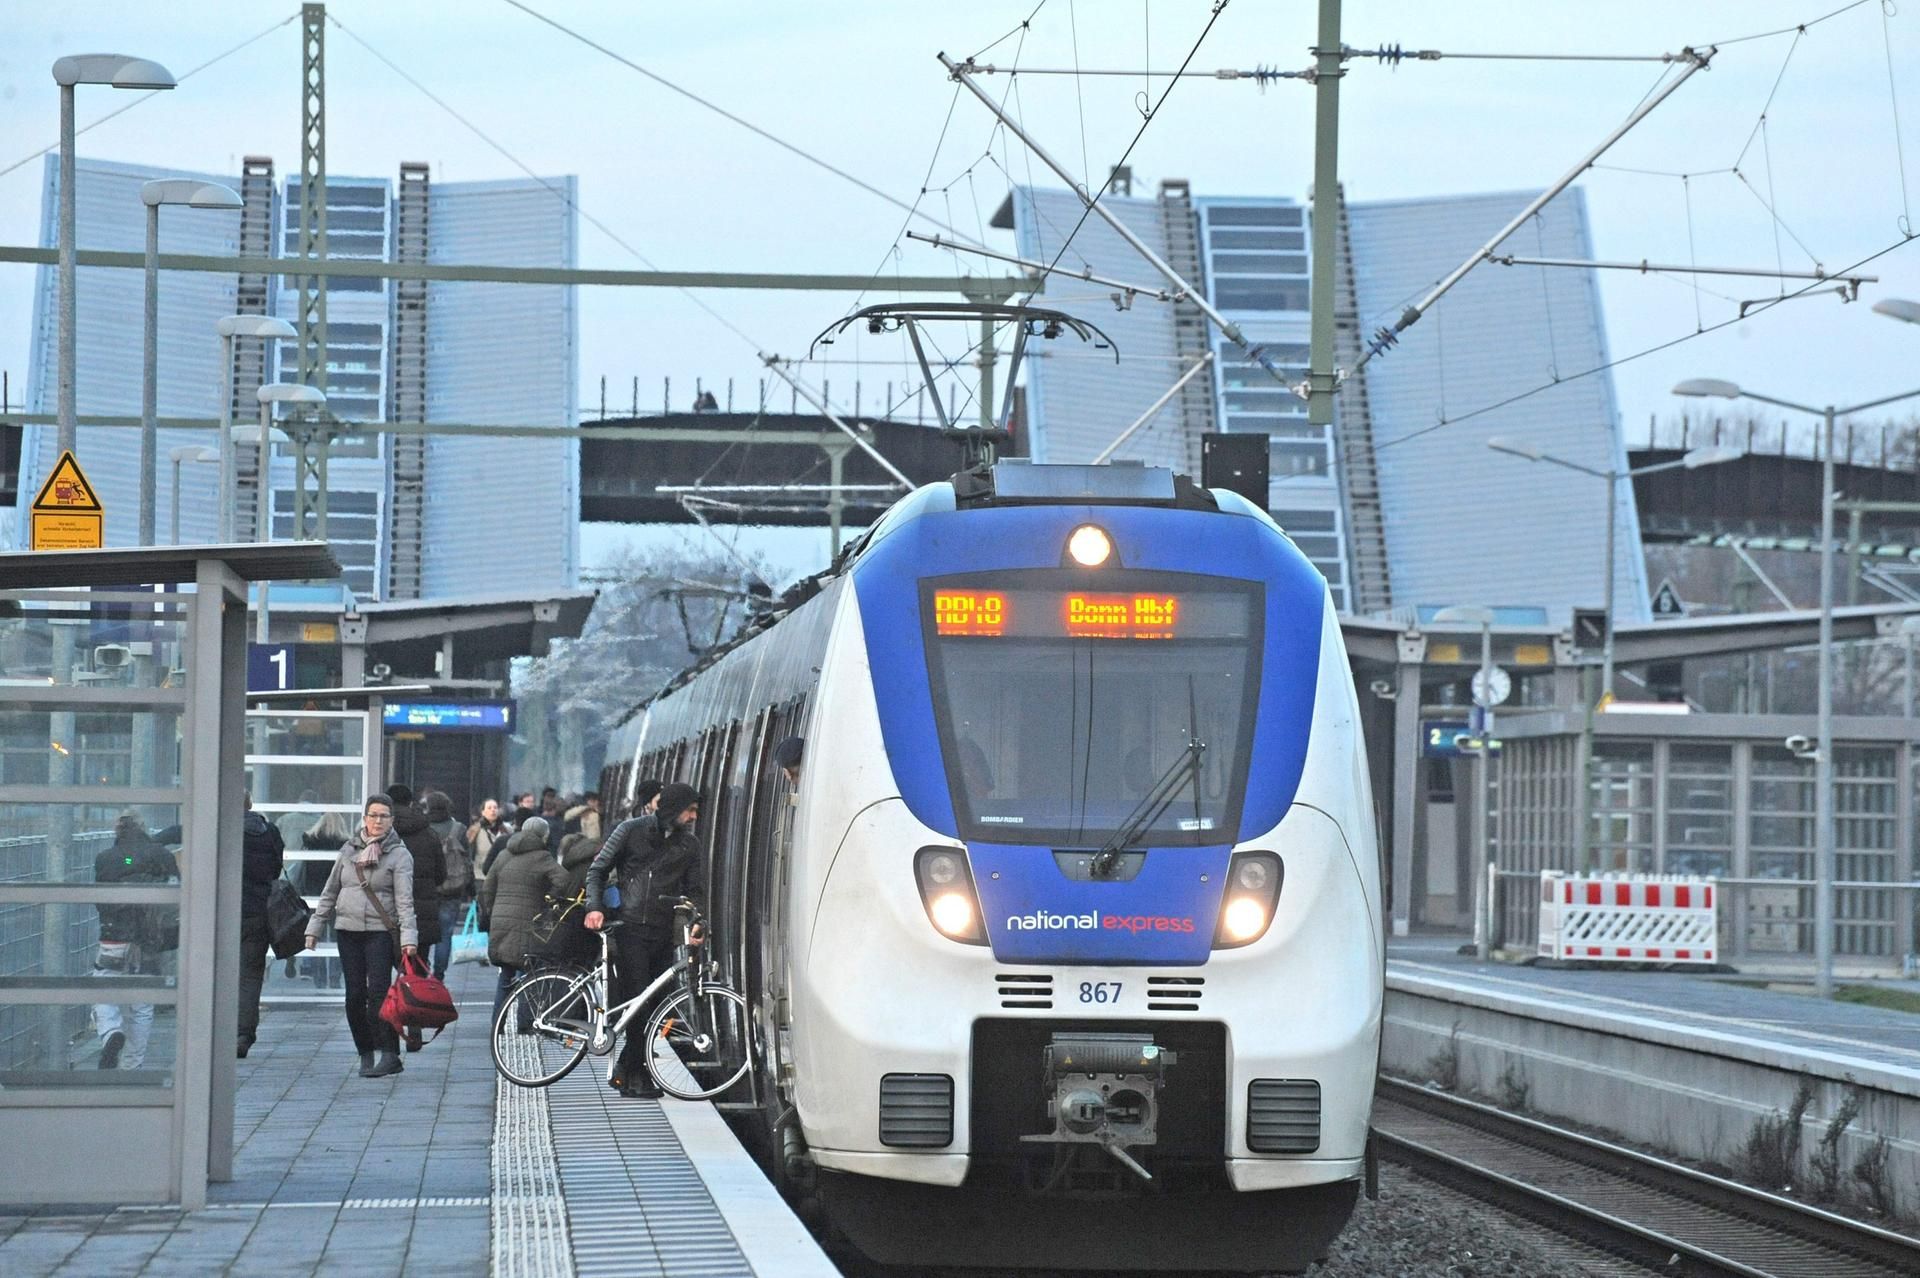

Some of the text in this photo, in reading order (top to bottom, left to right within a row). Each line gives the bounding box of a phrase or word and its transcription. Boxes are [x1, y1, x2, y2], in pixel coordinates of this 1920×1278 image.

[1070, 597, 1127, 624] Bonn
[1135, 597, 1174, 624] Hbf
[269, 649, 287, 689] 1
[501, 706, 509, 723] 1
[1430, 728, 1441, 745] 2
[1007, 910, 1195, 934] national express
[1079, 981, 1123, 1003] 867
